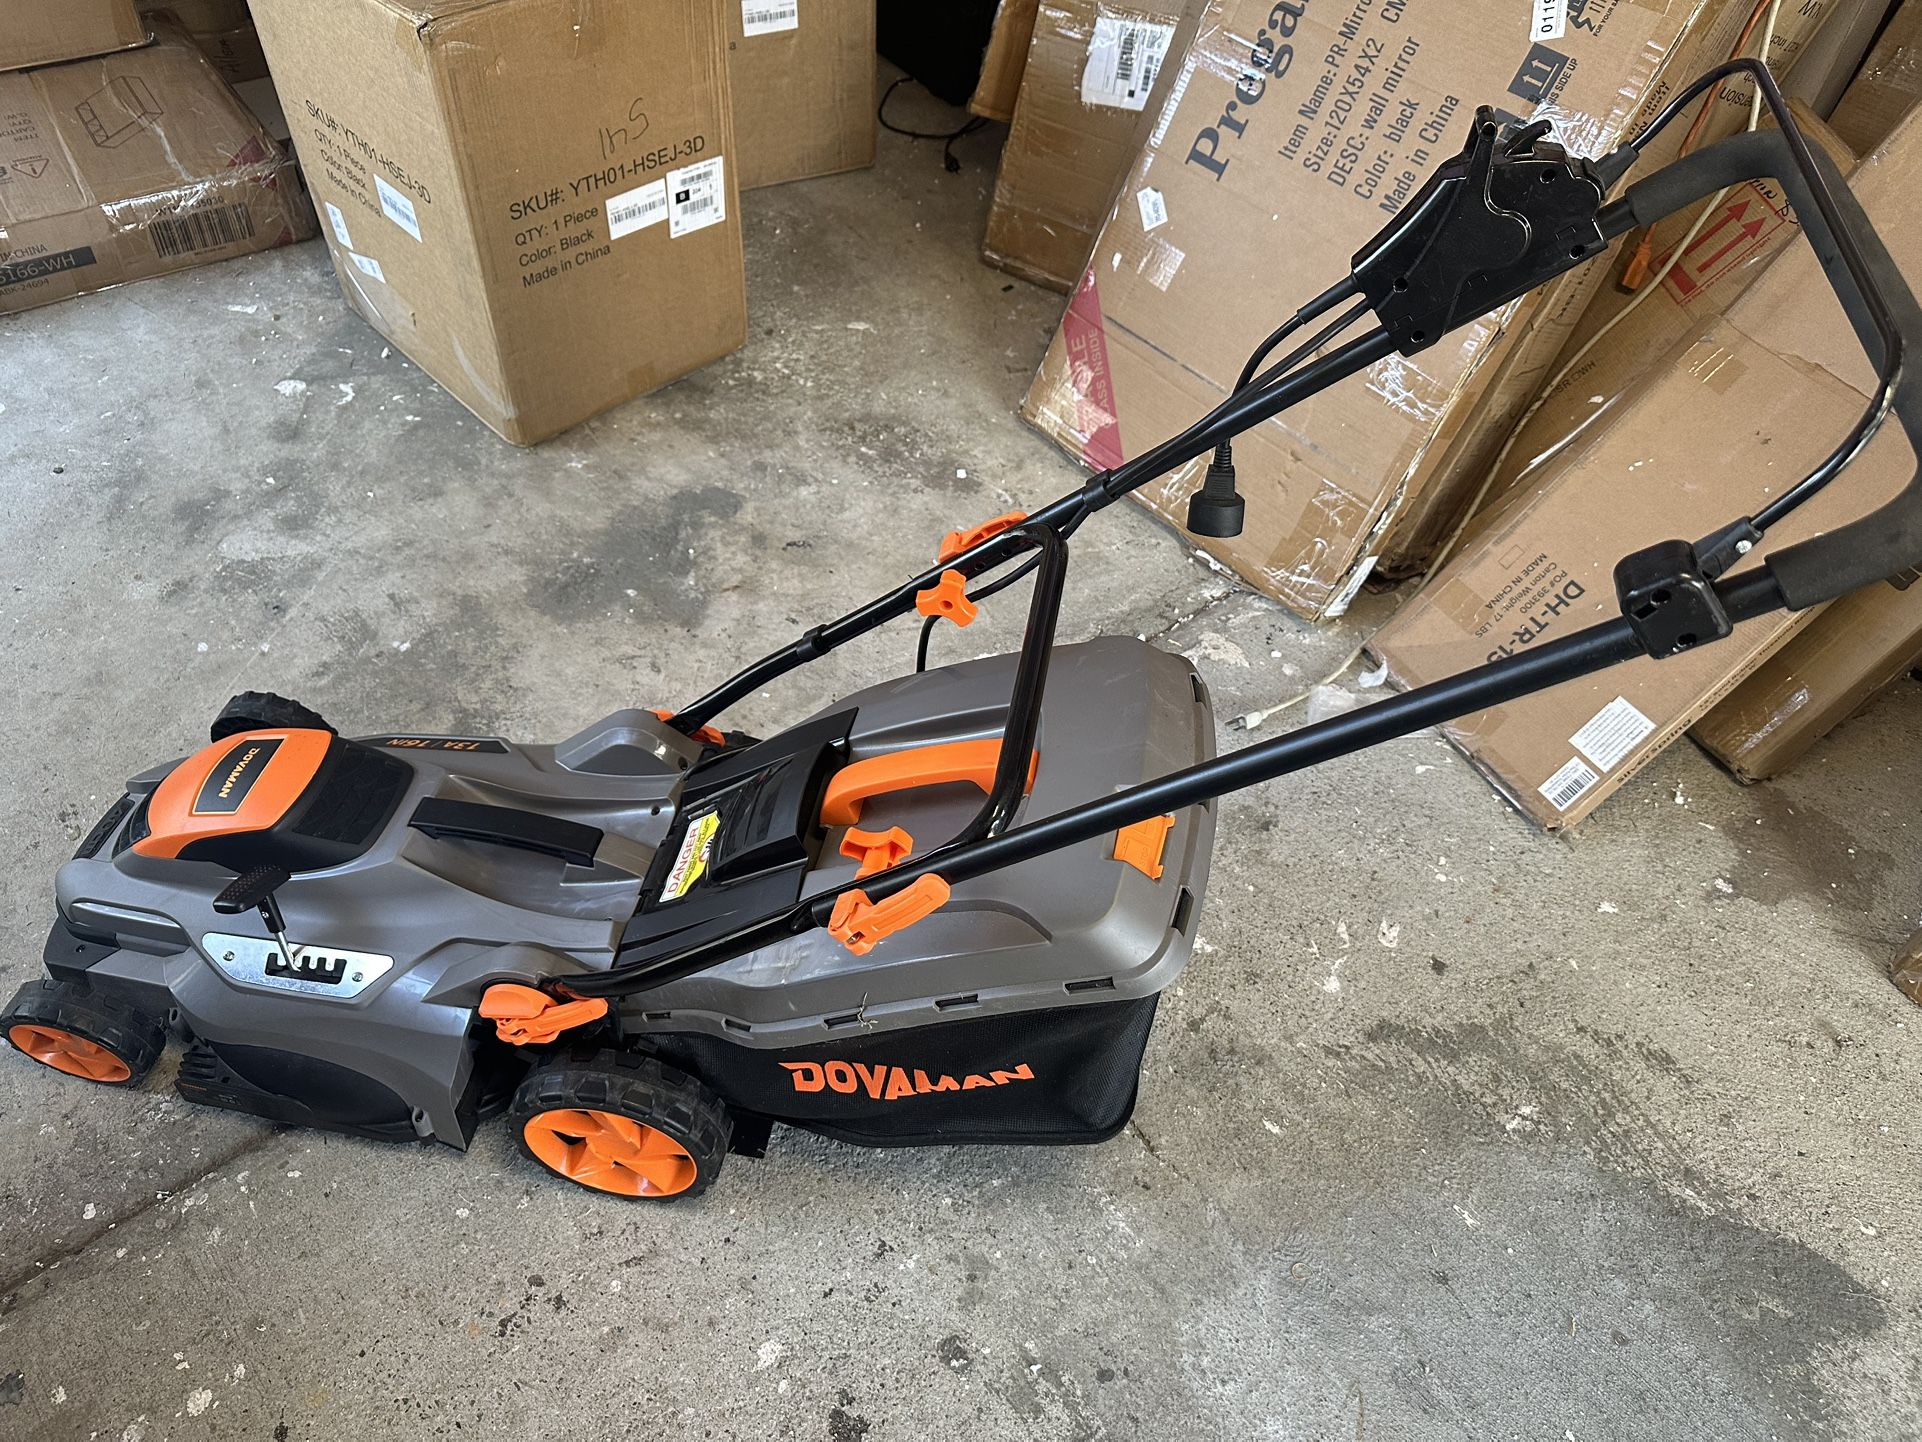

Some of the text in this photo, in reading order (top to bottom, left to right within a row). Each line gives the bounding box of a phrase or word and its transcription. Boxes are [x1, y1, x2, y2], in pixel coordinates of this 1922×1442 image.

[1593, 23, 1604, 37] FOR
[1600, 6, 1614, 25] YOUR
[1555, 74, 1572, 93] SIDE
[1567, 57, 1579, 73] UP
[305, 100, 341, 136] SKU#:
[1278, 123, 1309, 160] Item
[1298, 69, 1338, 121] Name:
[1327, 36, 1421, 188] DESC: wall mirror
[1629, 80, 1667, 136] Made in
[1648, 85, 1670, 116] Item
[1353, 98, 1420, 200] Color: black
[1379, 94, 1460, 215] Made in China
[509, 187, 566, 221] SKU#:
[569, 135, 705, 198] YTH01-HSEJ-3D
[514, 206, 599, 247] QTY: 1 Piece
[519, 228, 595, 268] Color: Black
[15, 244, 48, 259] CHINA
[522, 244, 611, 288] Made in China
[1474, 561, 1558, 639] Carton Weight: 17 LBS
[1485, 552, 1548, 610] MADE IN CHINA
[1519, 569, 1568, 614] PO# 393100
[218, 747, 262, 799] DOVAMAN
[667, 827, 699, 894] DANGER
[778, 1060, 1036, 1101] DOVAMAN
